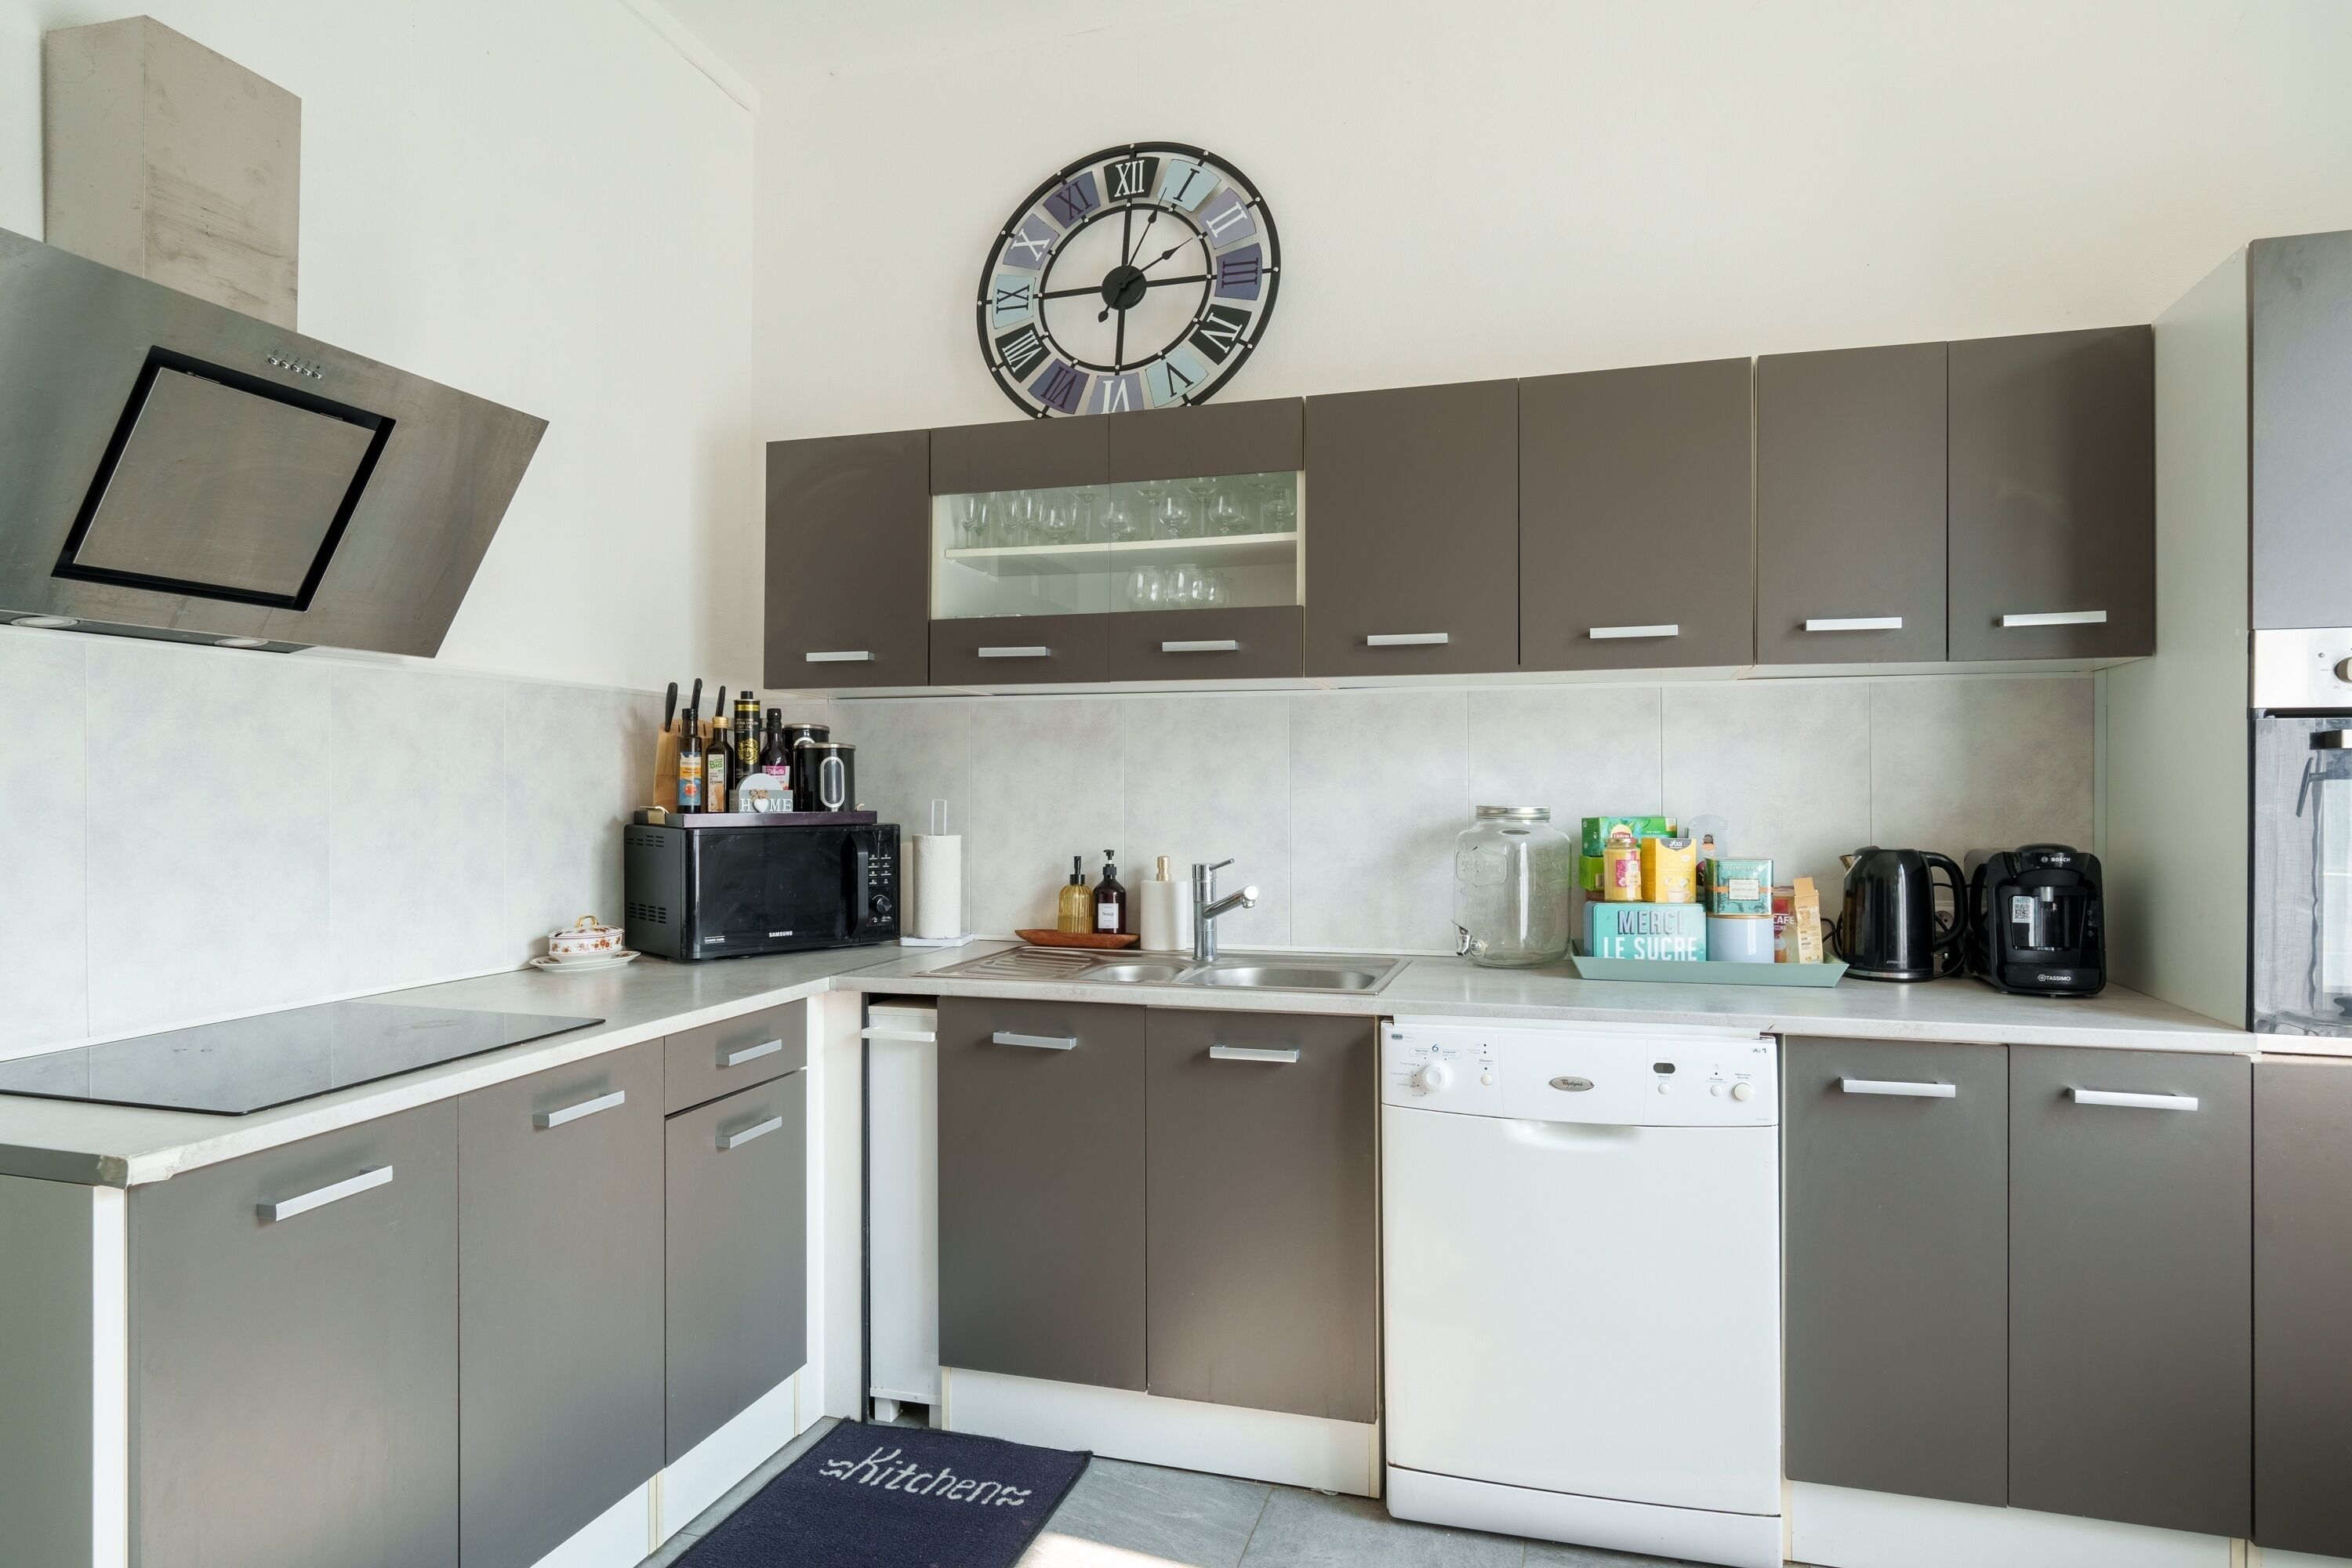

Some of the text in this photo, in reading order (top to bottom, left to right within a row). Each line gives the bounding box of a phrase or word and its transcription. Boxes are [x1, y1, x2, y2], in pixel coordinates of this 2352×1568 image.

[1113, 159, 1145, 198] XII
[1172, 168, 1200, 202] I
[1055, 180, 1093, 220] XI
[1206, 201, 1248, 239] II
[1011, 228, 1051, 261] X
[1221, 256, 1259, 289] III
[996, 284, 1030, 314] IX
[1002, 329, 1043, 373] VIII
[1200, 312, 1243, 354] IV
[1040, 367, 1071, 409] VII
[1166, 361, 1194, 398] V
[1617, 910, 1685, 935] MERCI
[1602, 937, 1699, 961] LE SUCRE
[840, 1447, 1002, 1504] Kitchen
